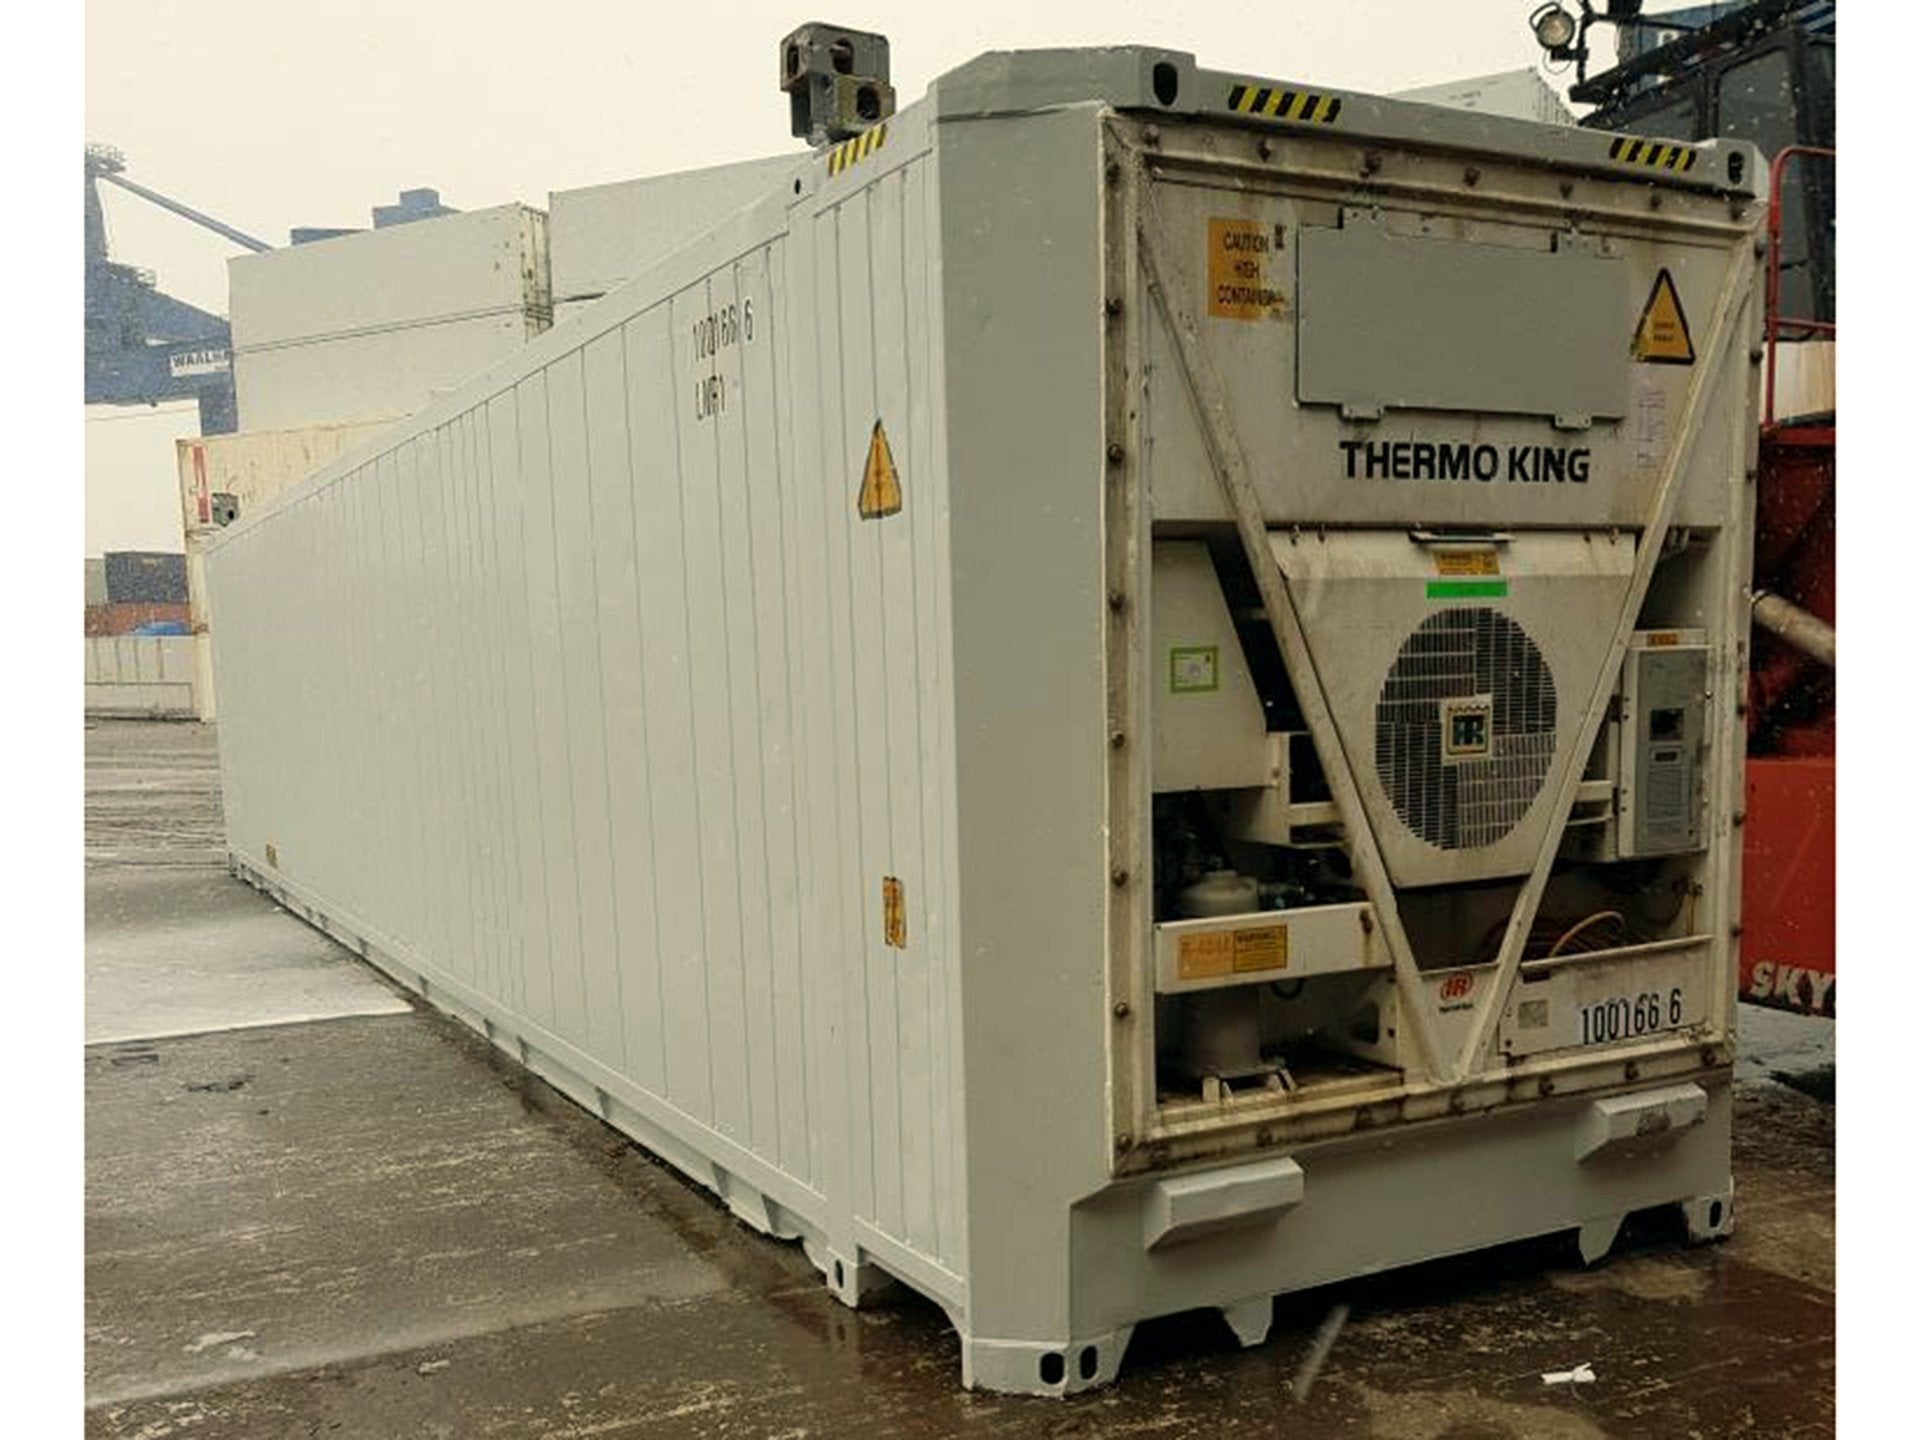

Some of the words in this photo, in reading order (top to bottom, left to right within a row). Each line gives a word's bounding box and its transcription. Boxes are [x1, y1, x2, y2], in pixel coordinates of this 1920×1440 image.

[1223, 231, 1270, 253] CAUTION
[744, 298, 754, 341] 6
[1339, 441, 1499, 482] THERMO
[1508, 446, 1591, 483] KING
[1749, 960, 1836, 1009] SKY
[1582, 993, 1660, 1046] 100166
[1669, 987, 1682, 1025] 6
